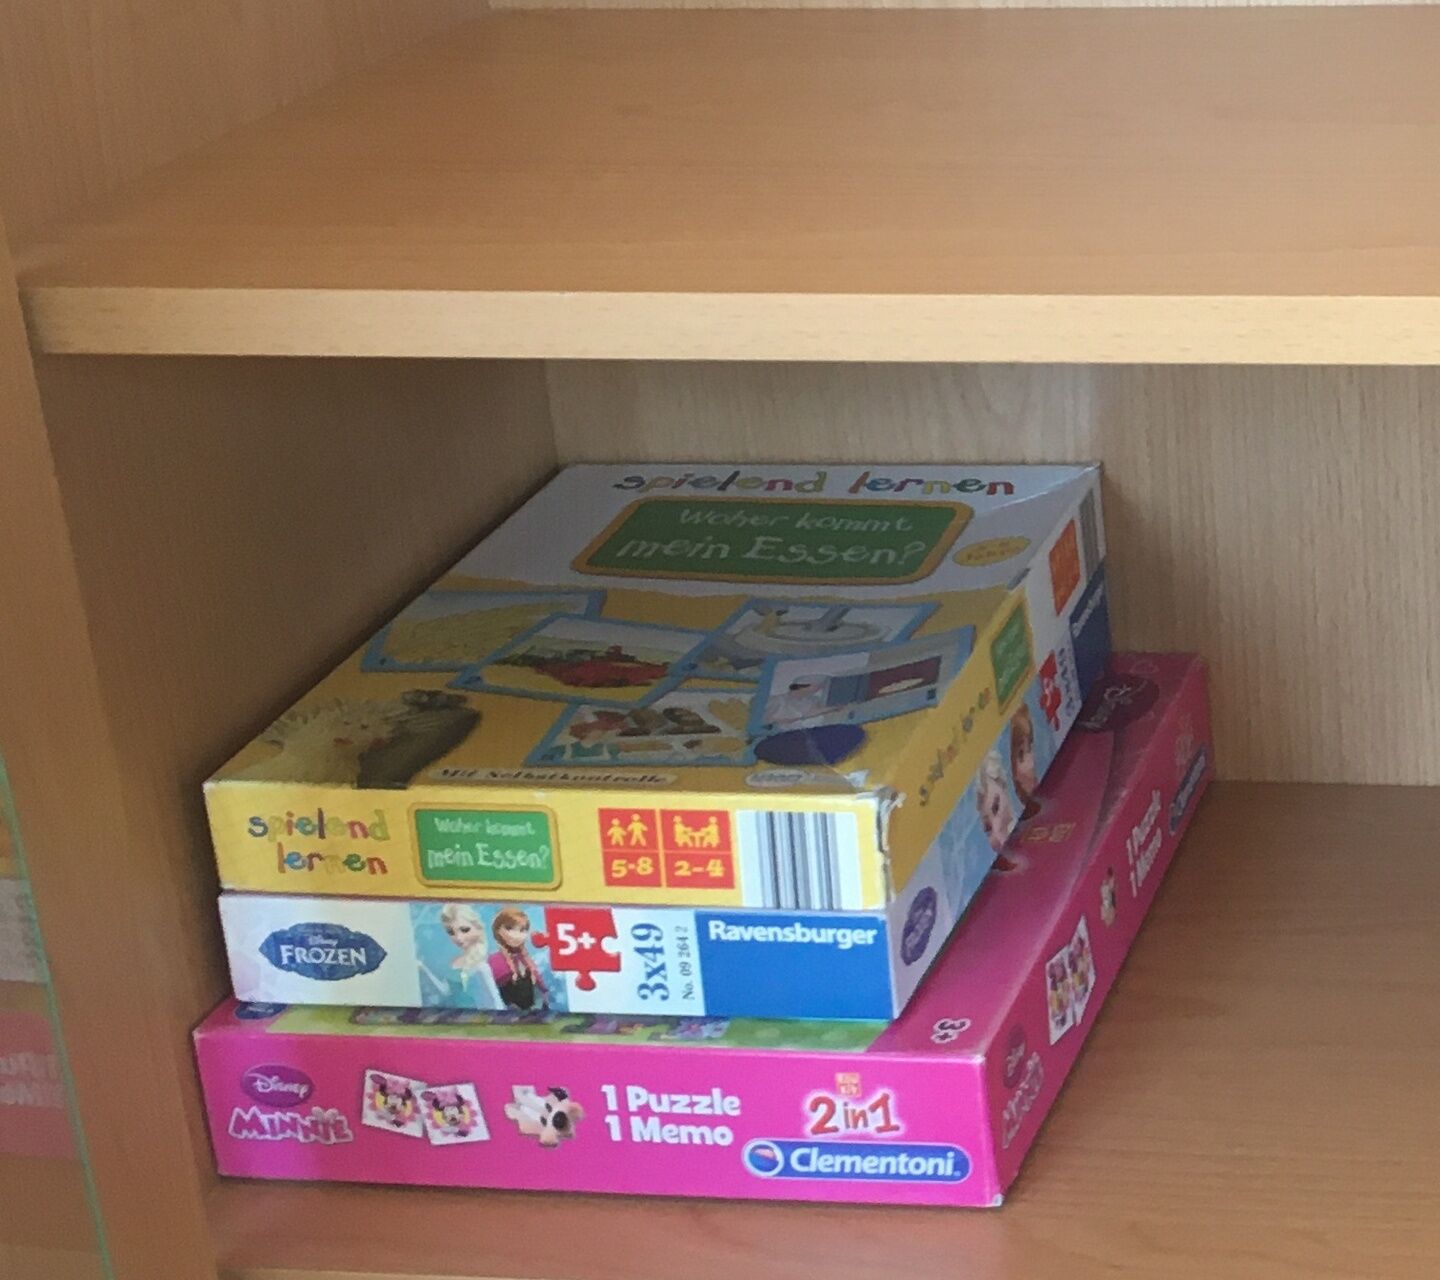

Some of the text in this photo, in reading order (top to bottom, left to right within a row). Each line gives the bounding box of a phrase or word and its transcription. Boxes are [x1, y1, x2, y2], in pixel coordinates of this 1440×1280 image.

[613, 470, 1016, 496] spielend lernen
[680, 509, 913, 533] Woher kommt
[616, 535, 731, 560] mein
[743, 535, 926, 565] Essen?
[247, 807, 391, 842] spielend
[277, 841, 388, 875] lernen
[427, 842, 551, 871] mein Essen?
[611, 858, 654, 878] 5-8
[556, 923, 596, 956] 5+
[707, 920, 878, 949] Ravensburger
[280, 944, 367, 966] FROZEN
[630, 923, 670, 1001] 3x49
[252, 1073, 310, 1098] Disney
[600, 1084, 742, 1117] 1 Puzzle
[604, 1114, 734, 1147] 1 Memo
[789, 1147, 955, 1176] Clementoni
